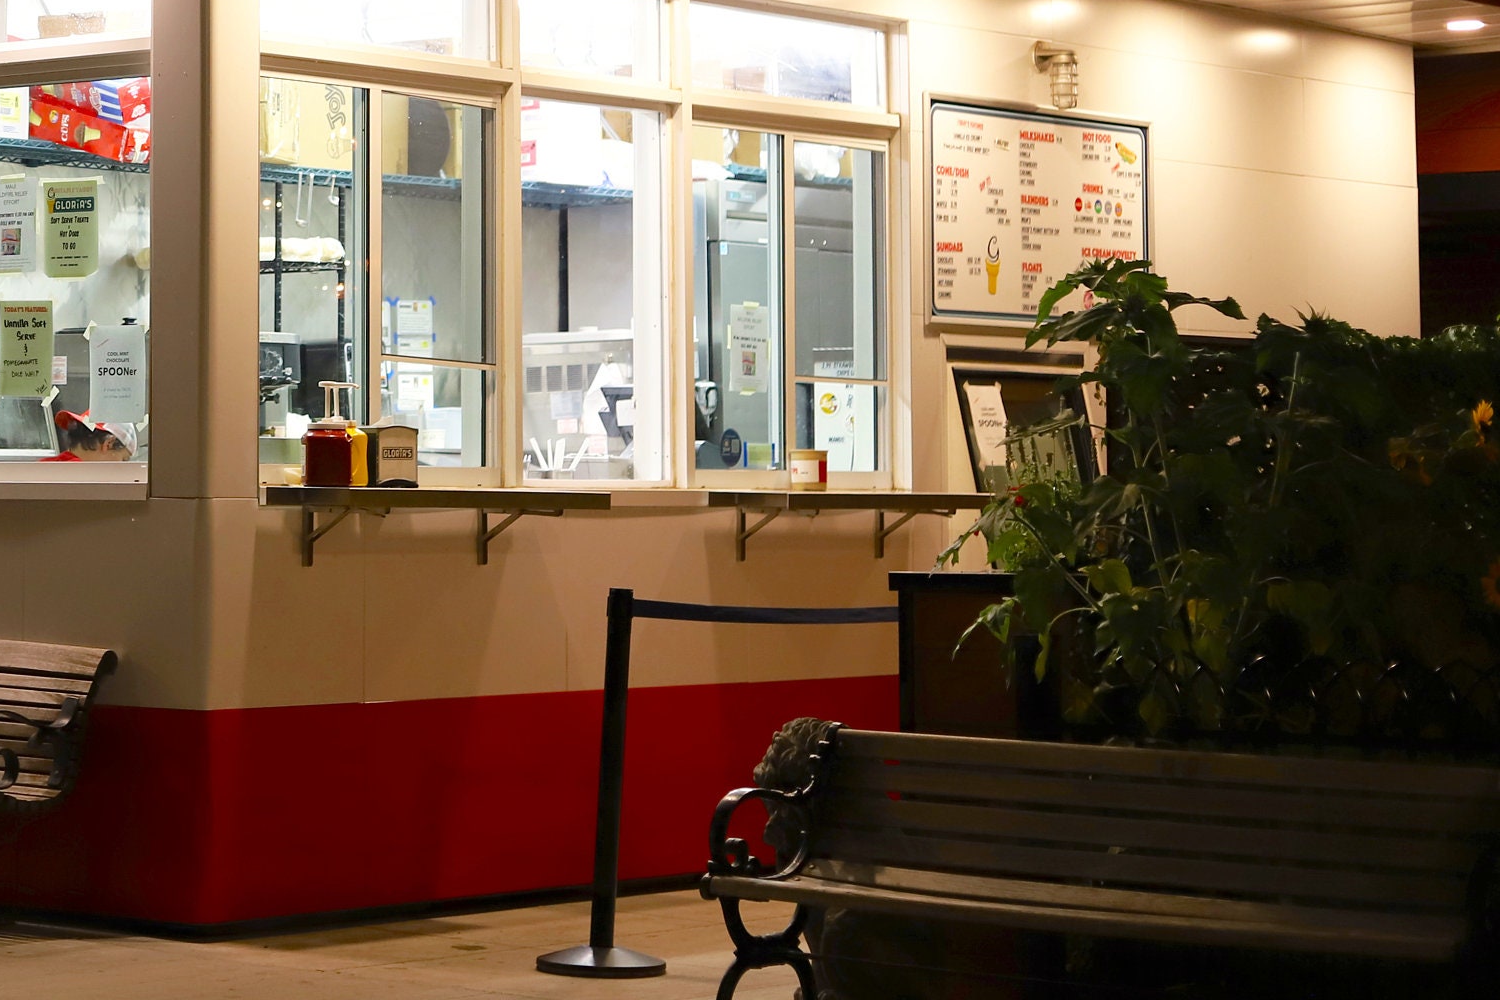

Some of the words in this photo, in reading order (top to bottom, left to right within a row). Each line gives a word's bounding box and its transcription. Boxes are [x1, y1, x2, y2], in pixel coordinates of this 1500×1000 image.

[325, 85, 347, 130] JOY
[60, 113, 70, 142] CUPS
[1020, 130, 1055, 142] MILKSHAKES
[1083, 132, 1094, 142] HOT
[1096, 133, 1111, 143] FOOD
[936, 165, 969, 178] CONE/DISH
[1083, 183, 1103, 195] DRINKS
[1021, 194, 1049, 207] BLENDERS
[62, 242, 68, 250] TO
[936, 242, 963, 253] SUNDAES
[1082, 247, 1091, 257] ICE
[1092, 248, 1111, 258] CREAM
[1022, 262, 1042, 273] FLOATS
[98, 366, 137, 376] SPOONer
